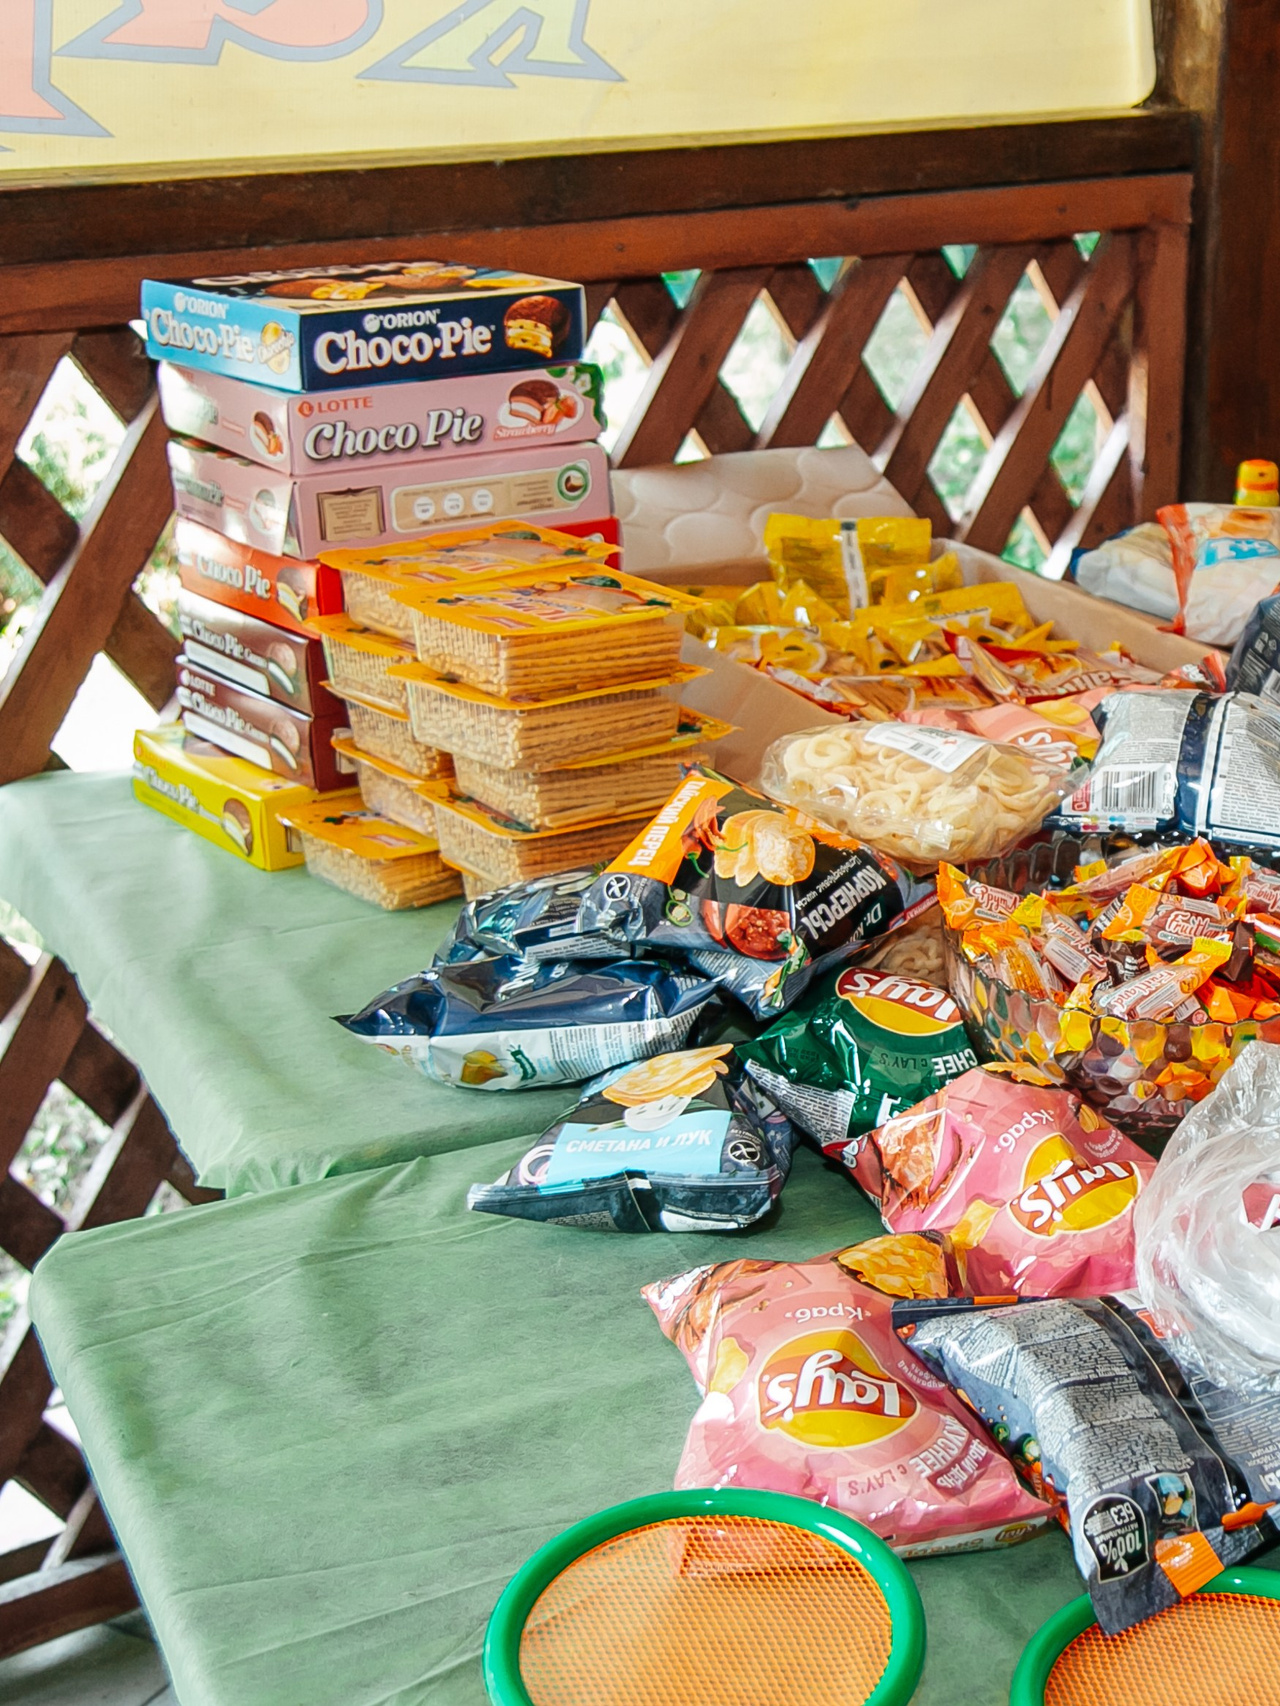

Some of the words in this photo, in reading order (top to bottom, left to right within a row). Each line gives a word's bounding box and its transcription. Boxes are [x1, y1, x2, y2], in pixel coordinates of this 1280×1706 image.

[187, 298, 227, 320] ORION
[381, 311, 438, 329] ORION
[317, 396, 374, 414] LOTTE
[304, 420, 419, 460] Choco
[422, 407, 484, 449] Pie
[244, 564, 271, 599] Pie
[655, 780, 707, 824] ТАЙСКИЙ
[627, 825, 671, 866] ПЕРЕЦ
[800, 864, 887, 940] КОРНЕРСЫ
[864, 903, 883, 926] Dr.
[844, 972, 957, 1021] Lay's
[879, 1052, 917, 1070] LAY'S
[566, 1138, 652, 1154] СМЕТАНА
[655, 1136, 670, 1148] И
[671, 1130, 714, 1147] ЛУК
[765, 1349, 901, 1422] Lay's
[846, 1468, 896, 1498] LAY'S
[1112, 1501, 1136, 1524] БЕЗ
[1098, 1534, 1143, 1564] 100%
